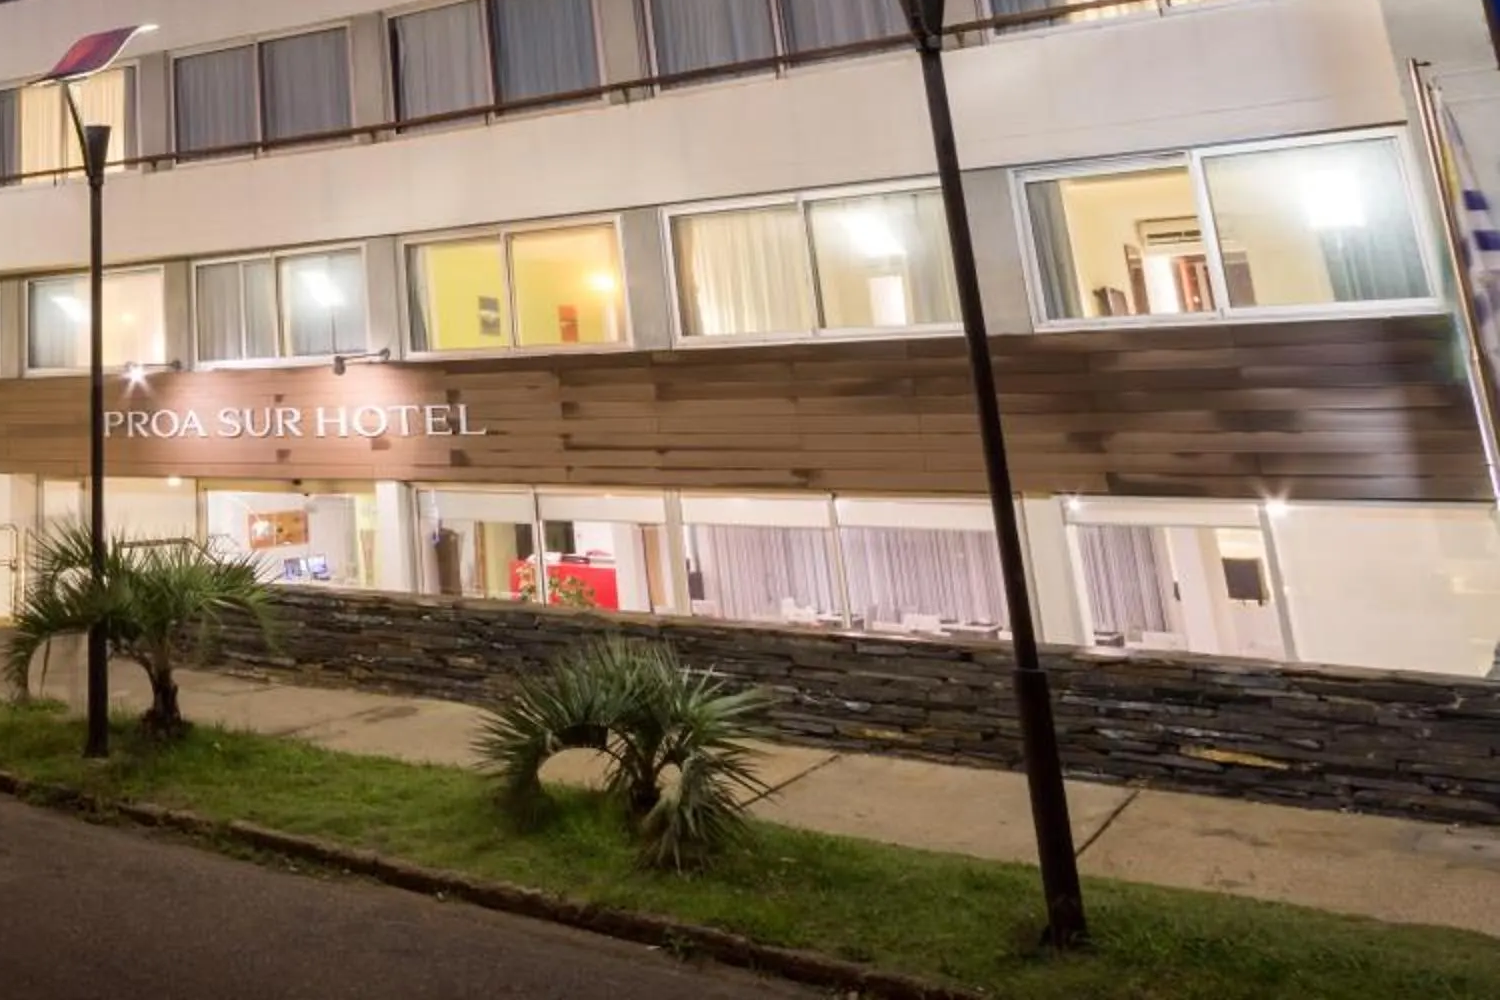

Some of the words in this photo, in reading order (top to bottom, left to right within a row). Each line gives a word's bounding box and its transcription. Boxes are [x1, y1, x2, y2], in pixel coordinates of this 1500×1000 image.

[104, 408, 208, 438] PROA
[217, 406, 303, 438] SUR
[315, 403, 487, 437] HOTEL
